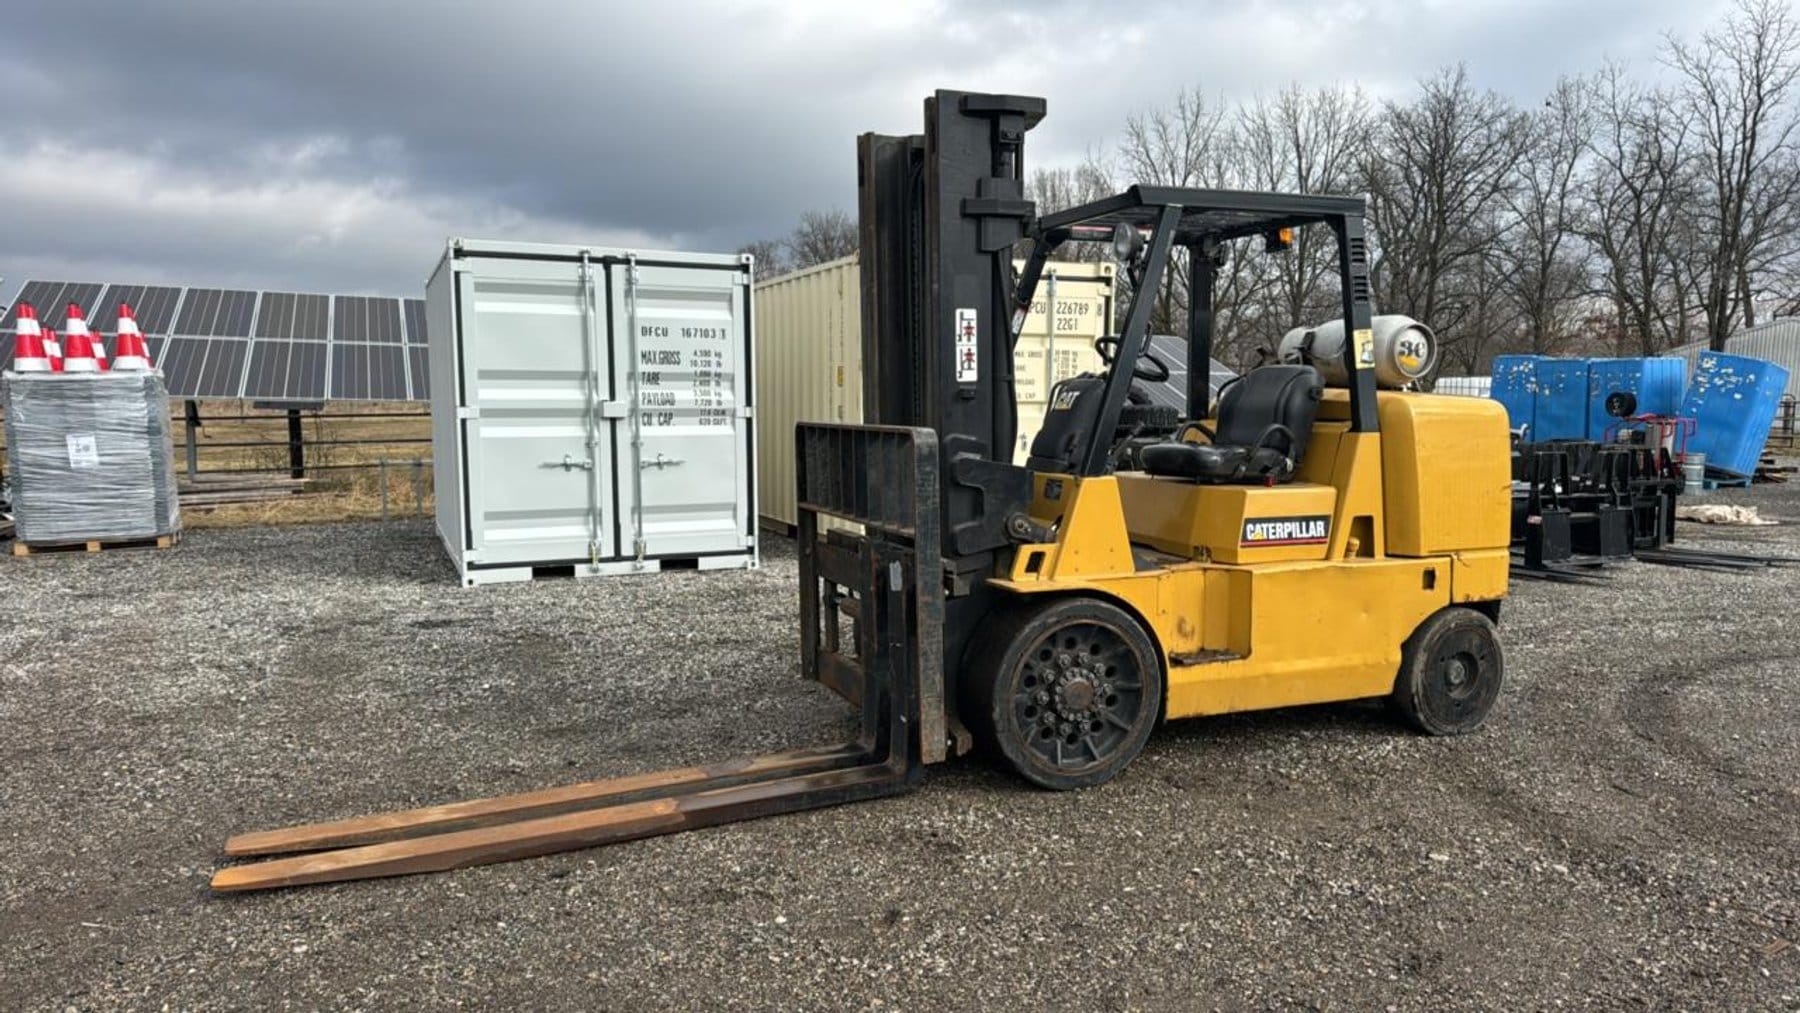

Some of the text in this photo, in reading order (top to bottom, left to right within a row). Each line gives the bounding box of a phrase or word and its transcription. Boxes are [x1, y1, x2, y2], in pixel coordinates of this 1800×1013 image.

[1056, 301, 1089, 315] 226789
[1057, 318, 1078, 331] 22G1
[641, 326, 668, 337] DFCU
[682, 328, 716, 339] 167103
[642, 371, 660, 385] TARE
[641, 391, 676, 406] PAYLOAD
[1246, 520, 1325, 541] CATERPILLAR
